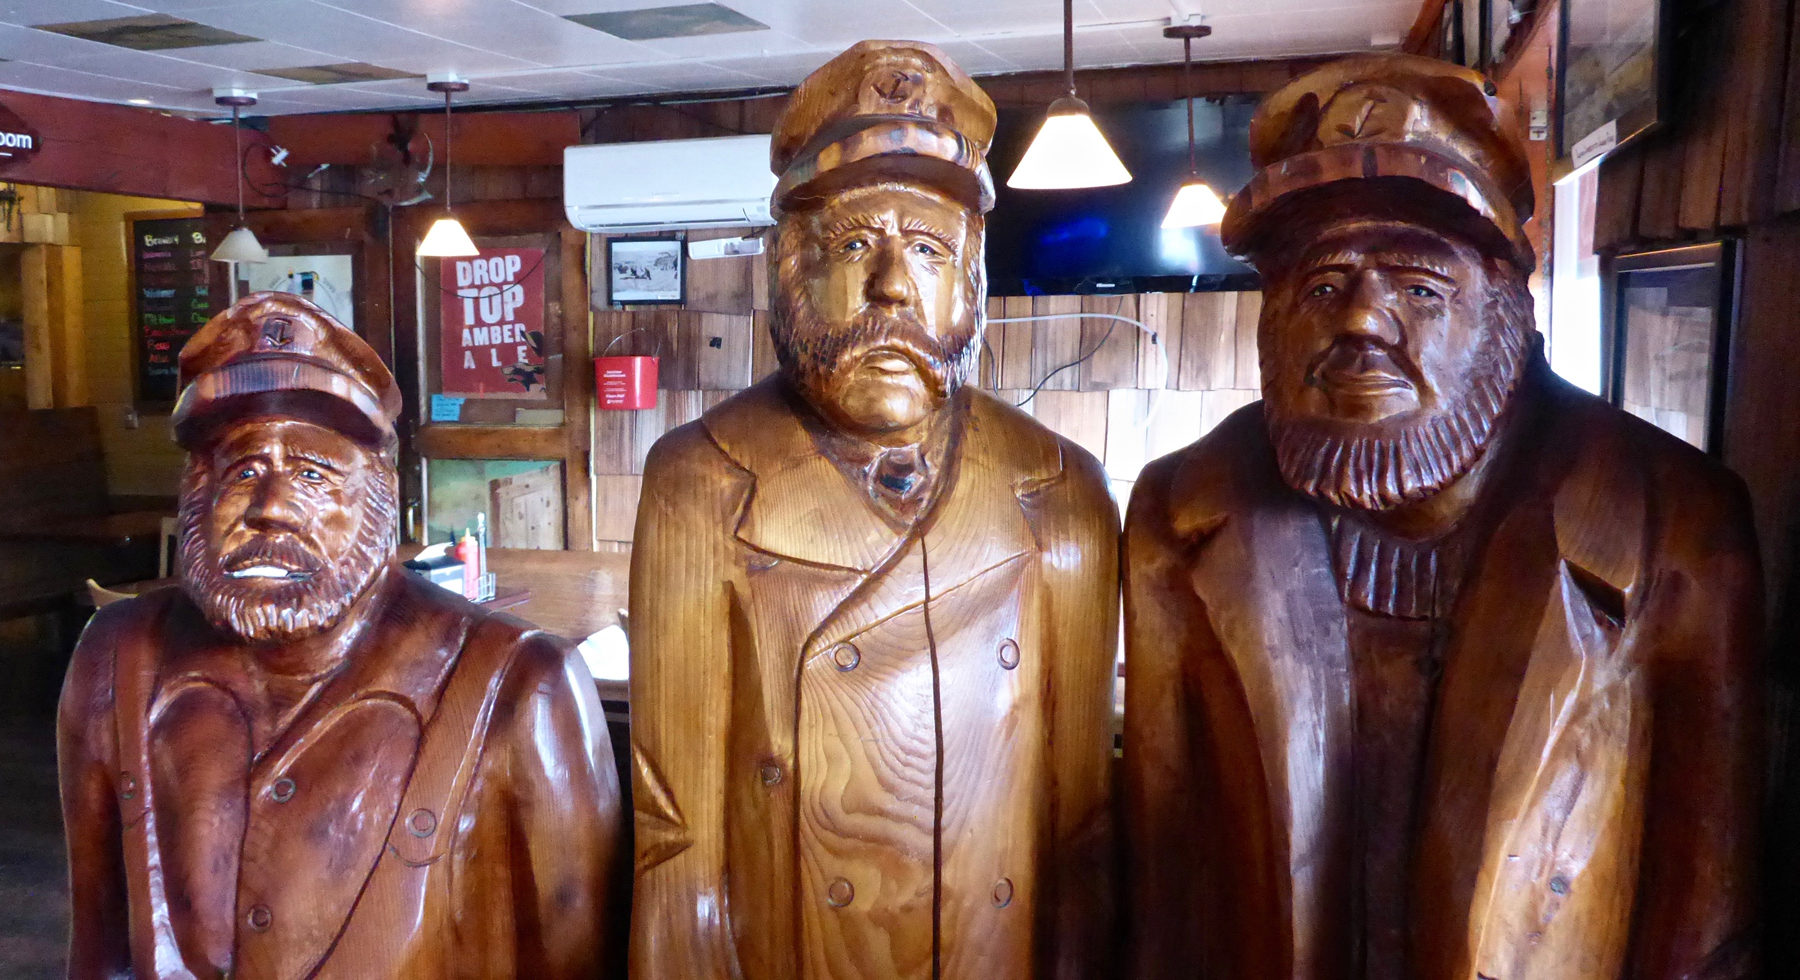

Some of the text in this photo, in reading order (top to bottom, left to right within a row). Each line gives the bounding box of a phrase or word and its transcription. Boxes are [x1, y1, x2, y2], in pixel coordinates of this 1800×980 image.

[456, 254, 522, 287] DROP
[457, 284, 525, 325] TOP
[462, 323, 527, 347] AMBER
